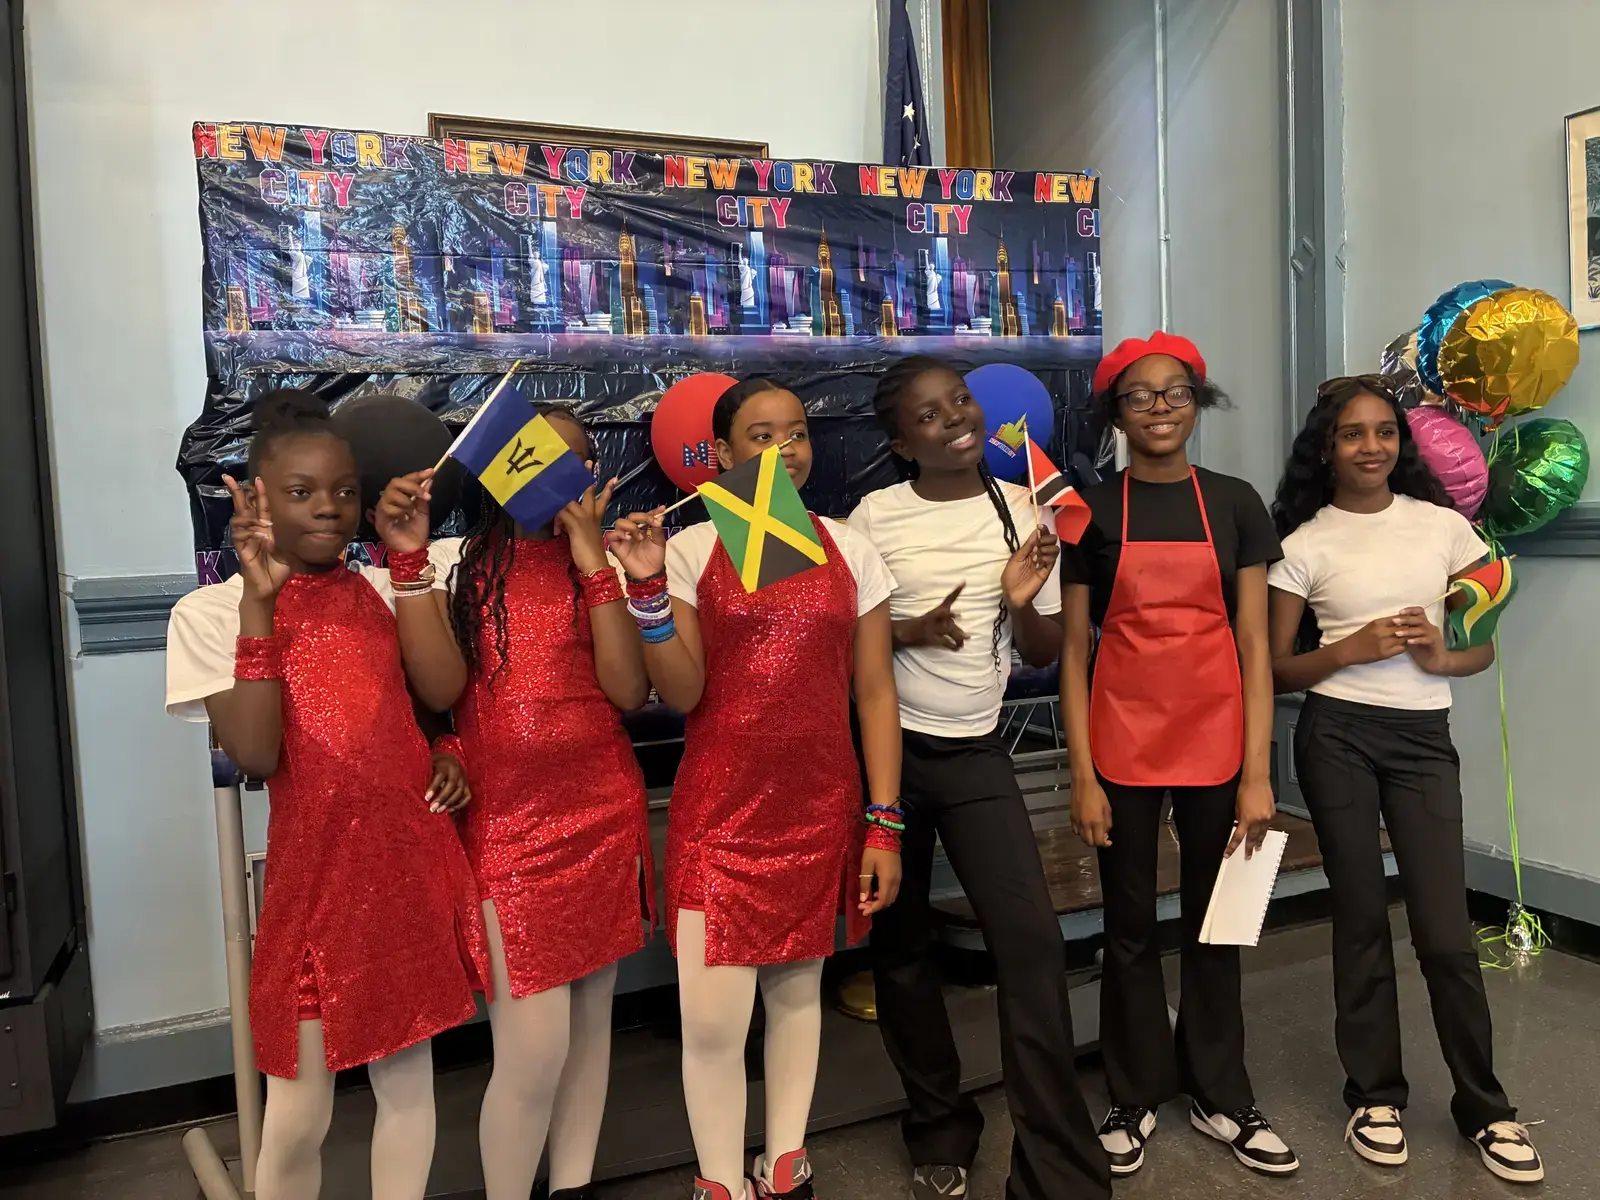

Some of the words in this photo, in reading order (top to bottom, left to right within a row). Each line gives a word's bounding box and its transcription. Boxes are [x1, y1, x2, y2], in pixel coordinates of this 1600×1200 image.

[194, 123, 287, 161] NEW
[301, 129, 413, 169] YORK
[443, 139, 529, 177] NEW
[541, 145, 638, 186] YORK
[259, 168, 355, 207] CITY
[664, 154, 740, 189] NEW
[752, 160, 837, 194] YORK
[859, 165, 928, 198] NEW
[937, 169, 1015, 202] YORK
[1034, 173, 1095, 204] NEW
[504, 181, 587, 219] CITY
[716, 195, 791, 228] CITY
[906, 202, 972, 235] CITY
